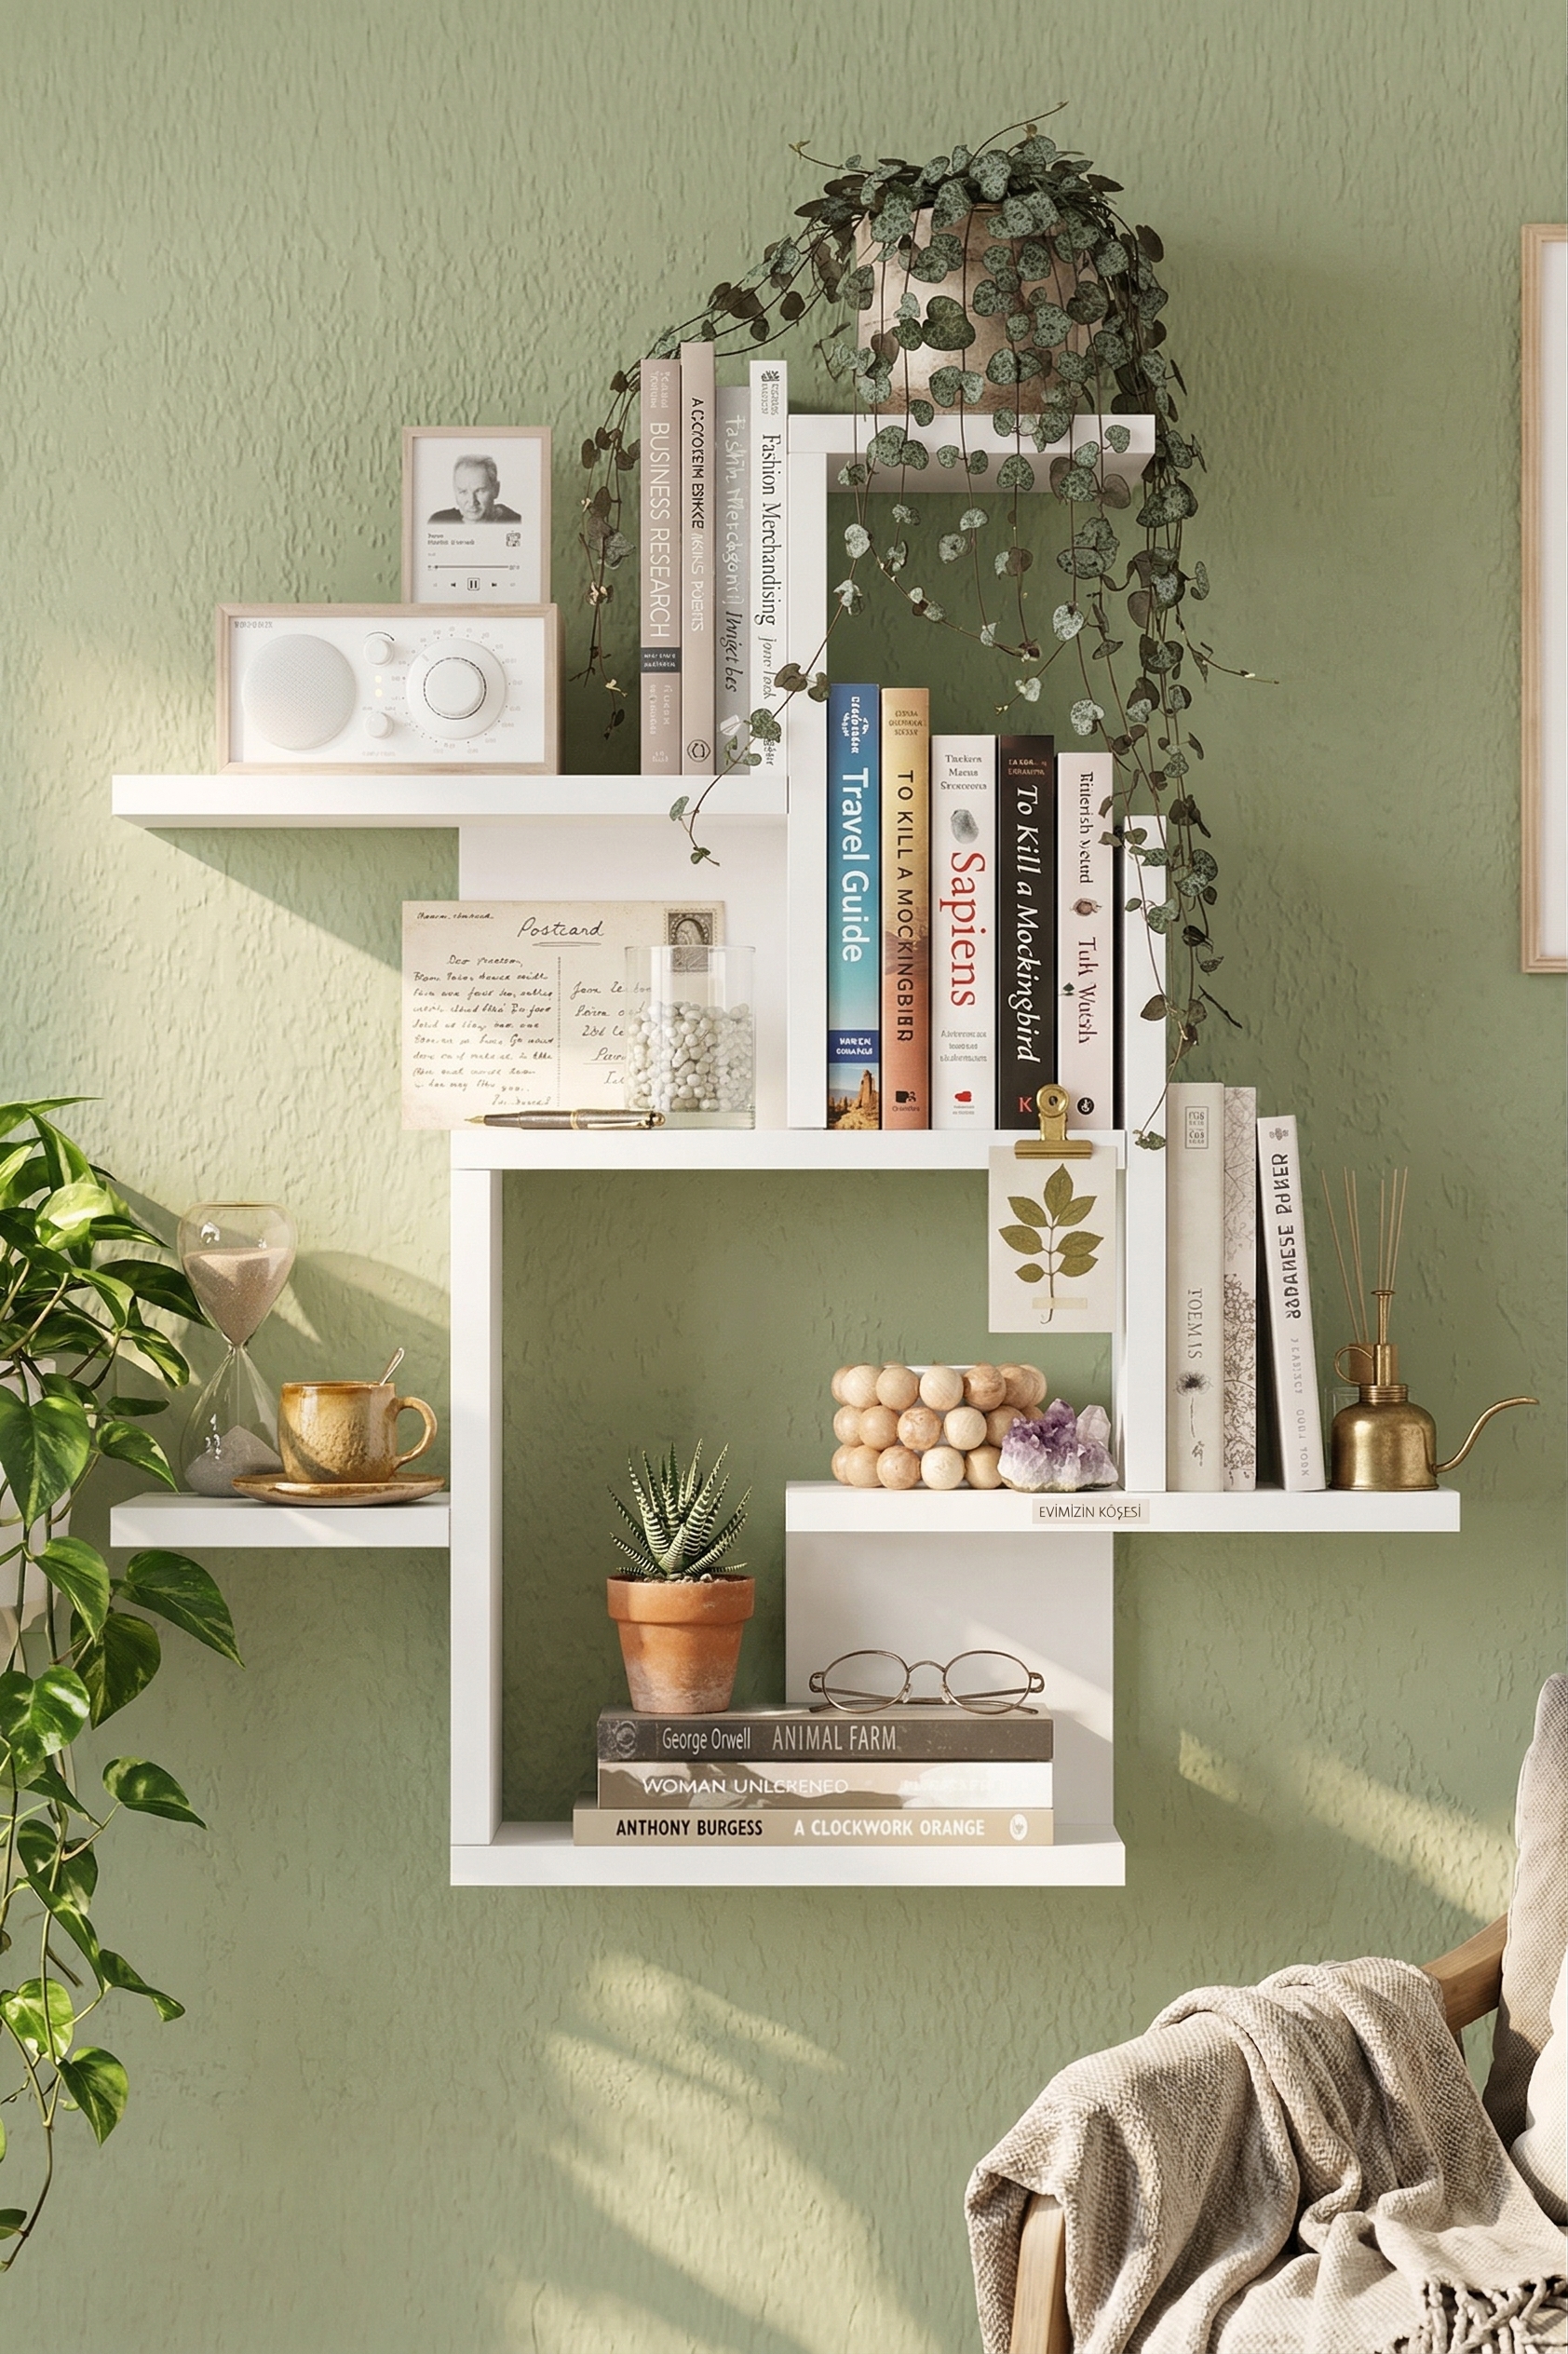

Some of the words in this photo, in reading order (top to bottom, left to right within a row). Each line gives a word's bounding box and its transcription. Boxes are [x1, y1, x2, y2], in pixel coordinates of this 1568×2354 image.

[649, 423, 671, 519] BUSINESS
[761, 434, 781, 495] Fashion
[649, 528, 671, 637] RESEARCH
[754, 502, 782, 625] Merchandising
[897, 770, 914, 801] TO
[1016, 785, 1039, 815] To
[841, 767, 869, 860] Travel
[897, 811, 914, 859] KILL
[1016, 824, 1040, 873] Kill
[897, 867, 914, 880] A
[1016, 881, 1034, 896] a
[517, 916, 605, 938] Postcard
[841, 871, 871, 962] Guide
[939, 852, 987, 1007] Sapiens
[1008, 904, 1040, 1062] Mockingbird
[1039, 1504, 1095, 1518] EVİMİZİN
[662, 1725, 707, 1755] George
[711, 1725, 751, 1751] Orwell
[772, 1726, 843, 1751] ANIMAL
[849, 1725, 897, 1751] FARM
[642, 1778, 726, 1793] WOMAN
[616, 1820, 690, 1836] ANTHONY
[696, 1820, 763, 1836] BURGESS
[794, 1820, 804, 1836] A
[811, 1820, 913, 1836] CLOCKWORK
[920, 1820, 985, 1836] ORANGE
